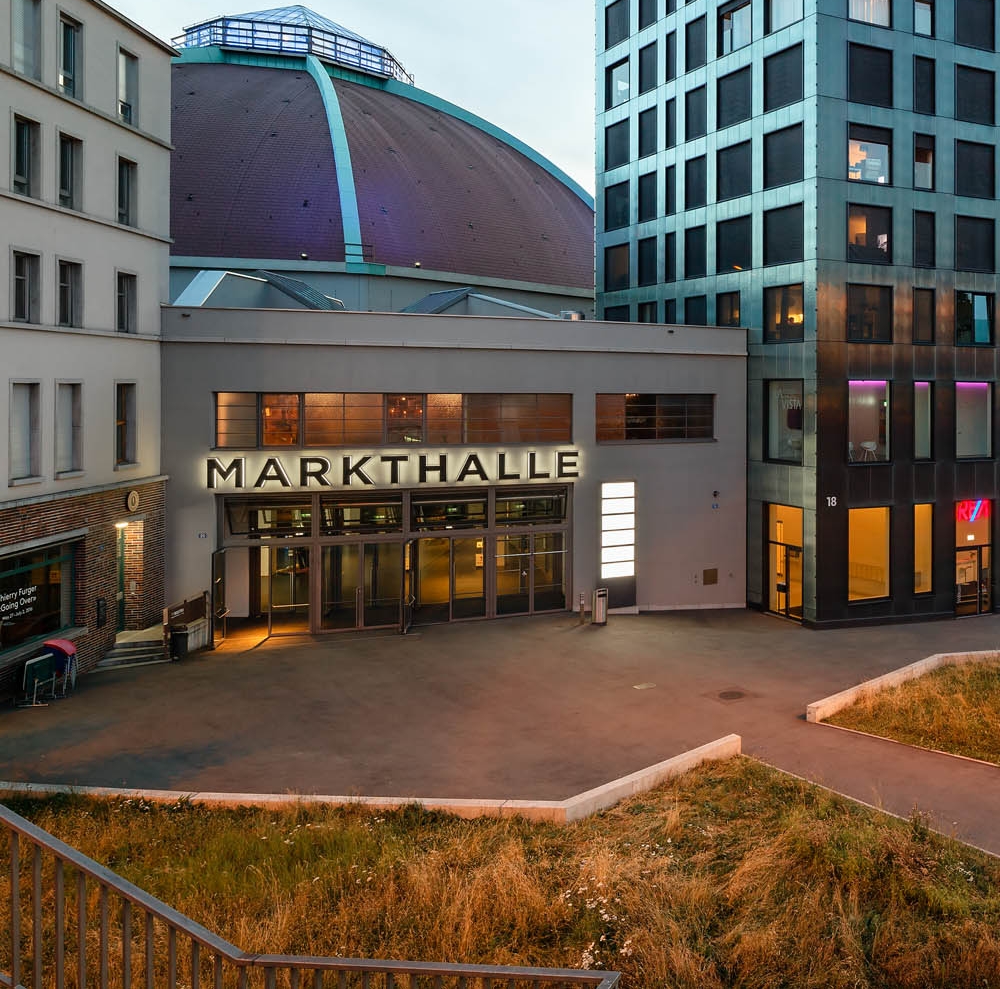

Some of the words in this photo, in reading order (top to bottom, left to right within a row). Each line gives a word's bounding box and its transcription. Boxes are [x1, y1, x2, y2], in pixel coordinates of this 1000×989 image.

[206, 450, 580, 489] MARKTHALLE
[826, 496, 837, 507] 18
[0, 592, 18, 602] hierry
[18, 585, 37, 596] Furger
[0, 602, 19, 612] Going
